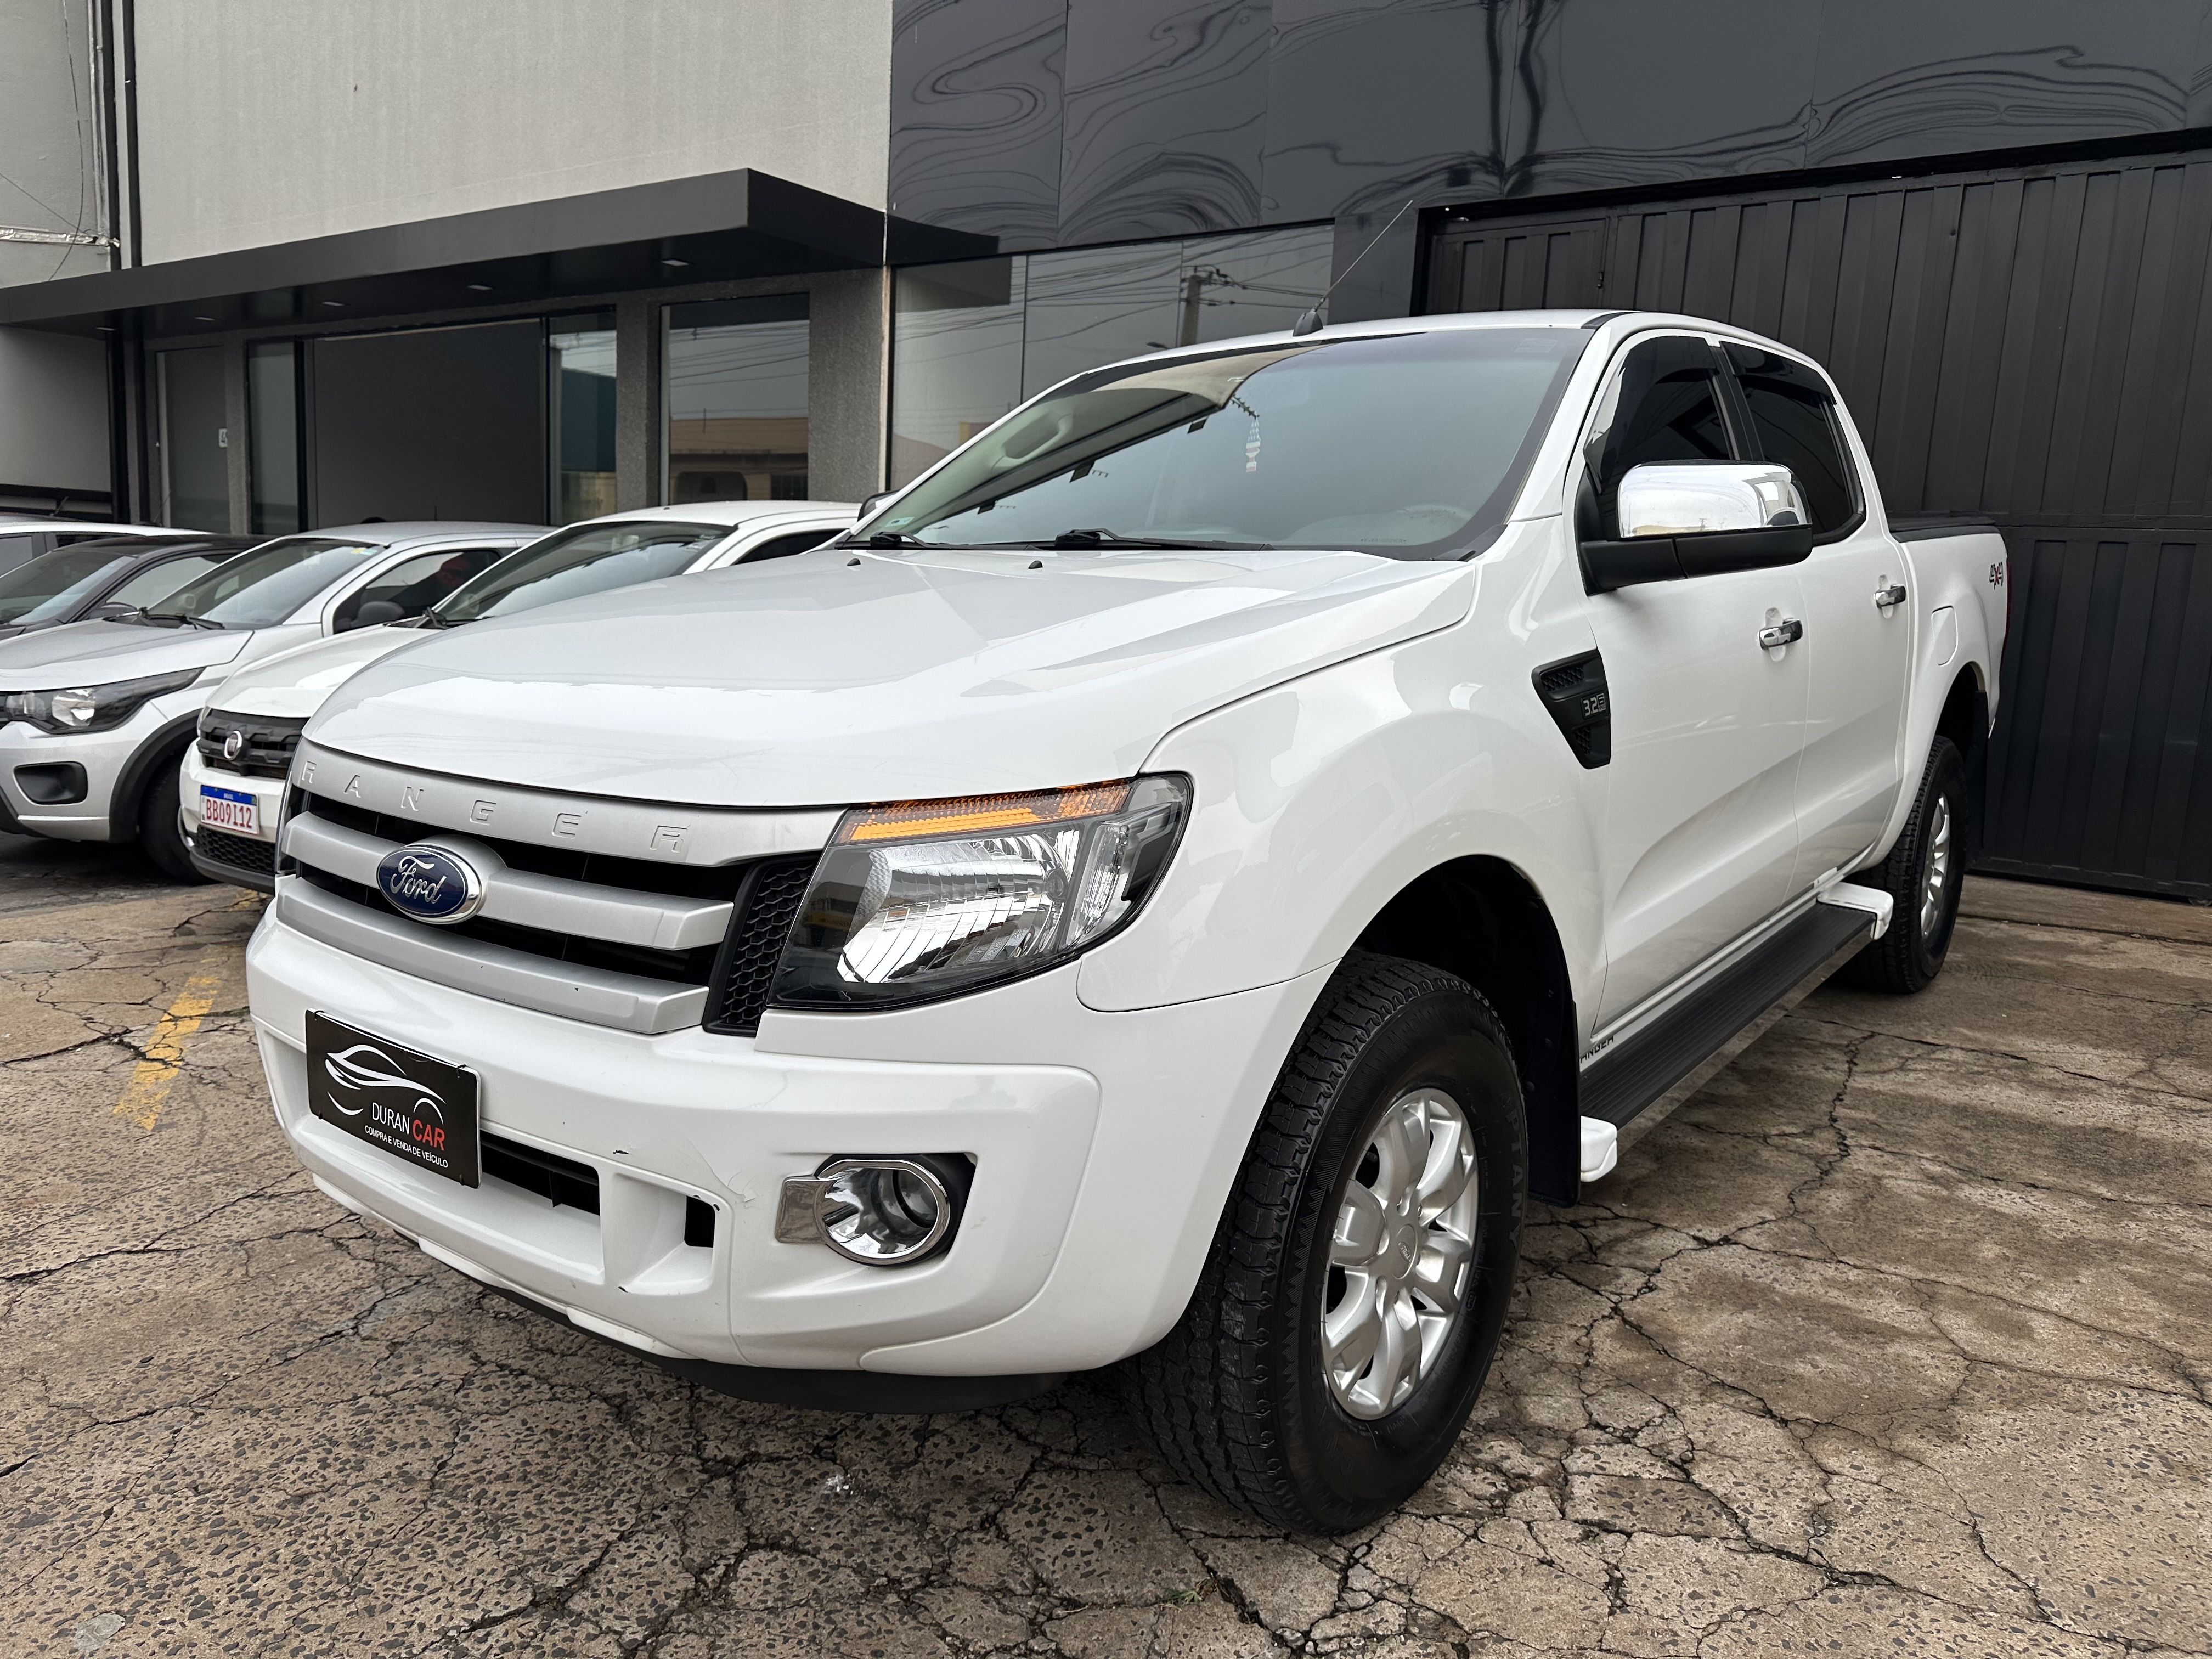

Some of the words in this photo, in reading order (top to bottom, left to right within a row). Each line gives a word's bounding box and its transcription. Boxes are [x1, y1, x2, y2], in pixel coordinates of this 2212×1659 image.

[1583, 697, 1598, 716] 3.2
[302, 760, 688, 853] RANGER
[390, 856, 447, 904] Ford
[365, 1125, 388, 1142] COMPRA
[388, 1135, 392, 1144] E
[393, 1137, 413, 1153] VENDA
[413, 1146, 421, 1157] DE
[422, 1150, 448, 1169] VEÍCULO
[372, 1102, 410, 1135] DURAN
[413, 1119, 445, 1151] CAR
[1499, 1091, 1524, 1256] APTANY
